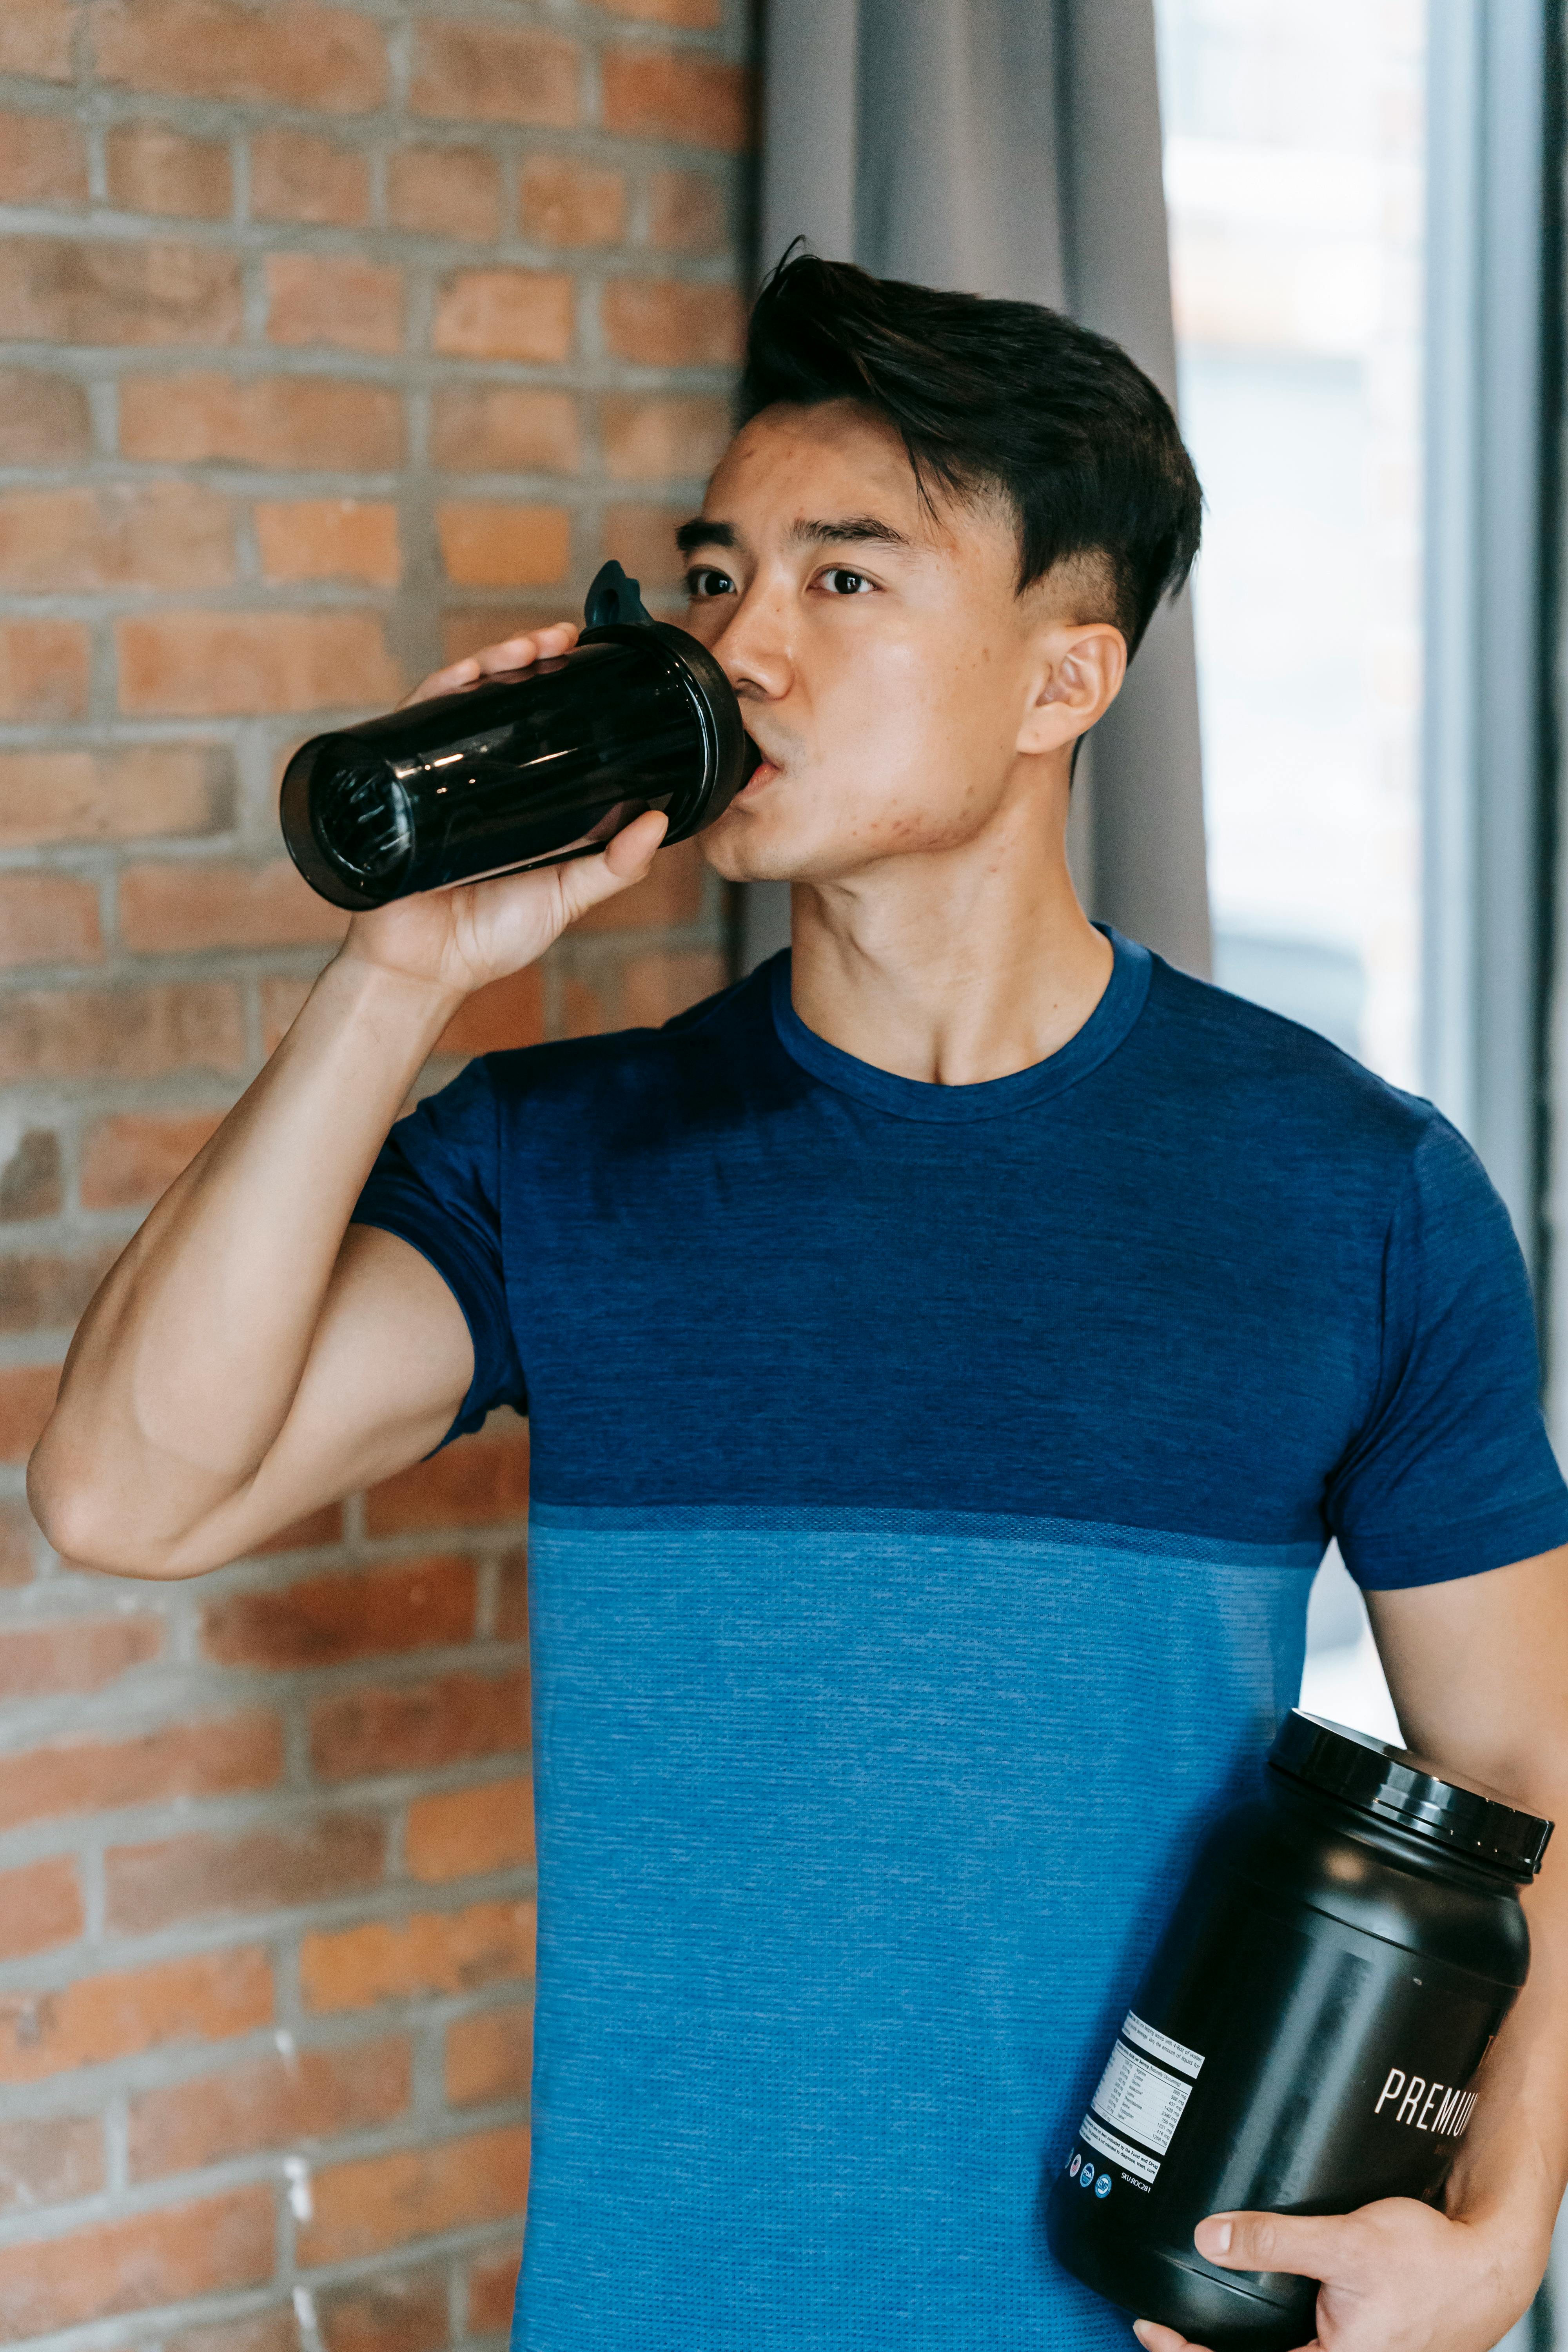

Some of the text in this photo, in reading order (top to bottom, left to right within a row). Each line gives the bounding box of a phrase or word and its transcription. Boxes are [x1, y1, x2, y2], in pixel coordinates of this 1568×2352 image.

[1155, 2033, 1164, 2042] scoop
[1190, 2053, 1202, 2063] water,
[1161, 2046, 1176, 2056] amount
[1181, 2056, 1193, 2065] liquid
[1139, 2060, 1149, 2069] Serving
[1163, 2074, 1181, 2087] Occurring)
[1105, 2141, 1116, 2152] intended
[1120, 2152, 1135, 2164] diagnose,
[1107, 2136, 1120, 2147] evaluated
[1149, 2161, 1158, 2170] Drug
